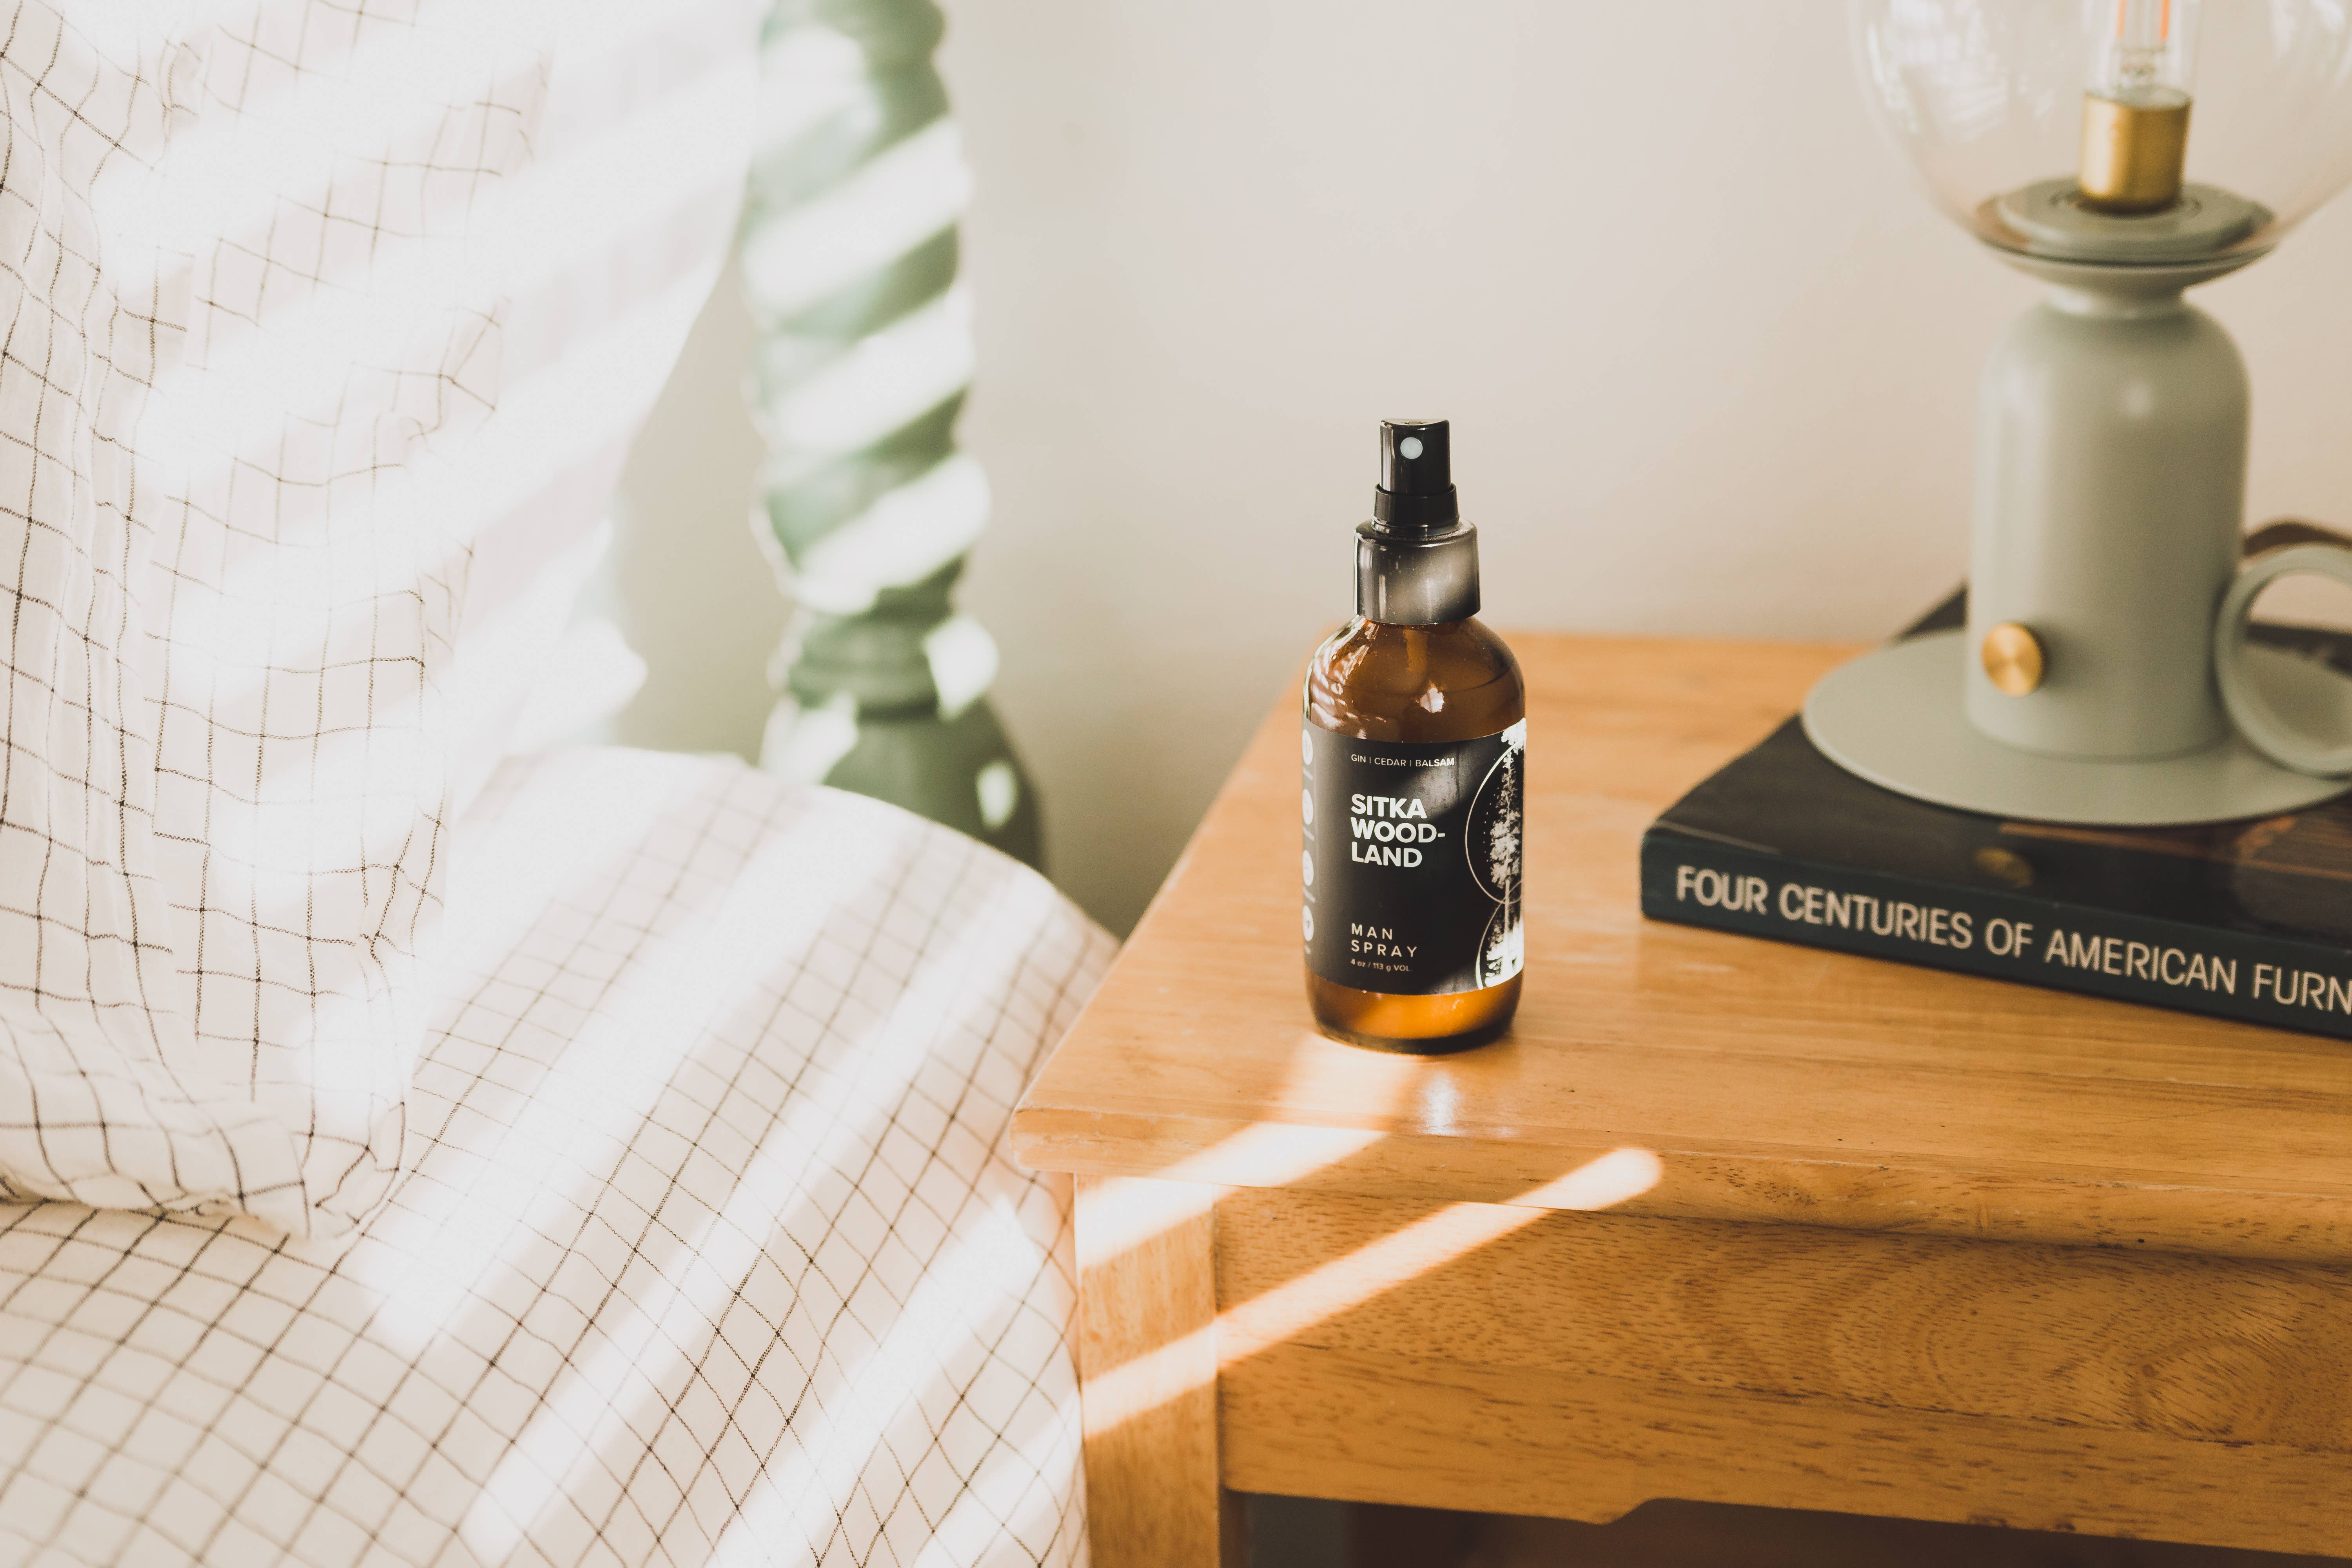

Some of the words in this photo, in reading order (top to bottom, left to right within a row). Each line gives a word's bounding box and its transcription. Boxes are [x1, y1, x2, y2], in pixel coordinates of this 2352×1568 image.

[1351, 754, 1366, 763] GIN
[1374, 757, 1406, 766] CEDAR
[1416, 757, 1455, 767] BALSAM
[1351, 793, 1427, 819] SITKA
[1350, 817, 1446, 843] WOOD-
[1352, 841, 1423, 867] LAND
[1351, 922, 1392, 940] MAN
[1676, 865, 1768, 914] FOUR
[1778, 883, 1973, 949] CENTURIES
[1984, 918, 2033, 957] OF
[2045, 929, 2237, 994] AMERICAN
[2253, 963, 2352, 1015] FURN
[1351, 939, 1417, 958] SPRAY
